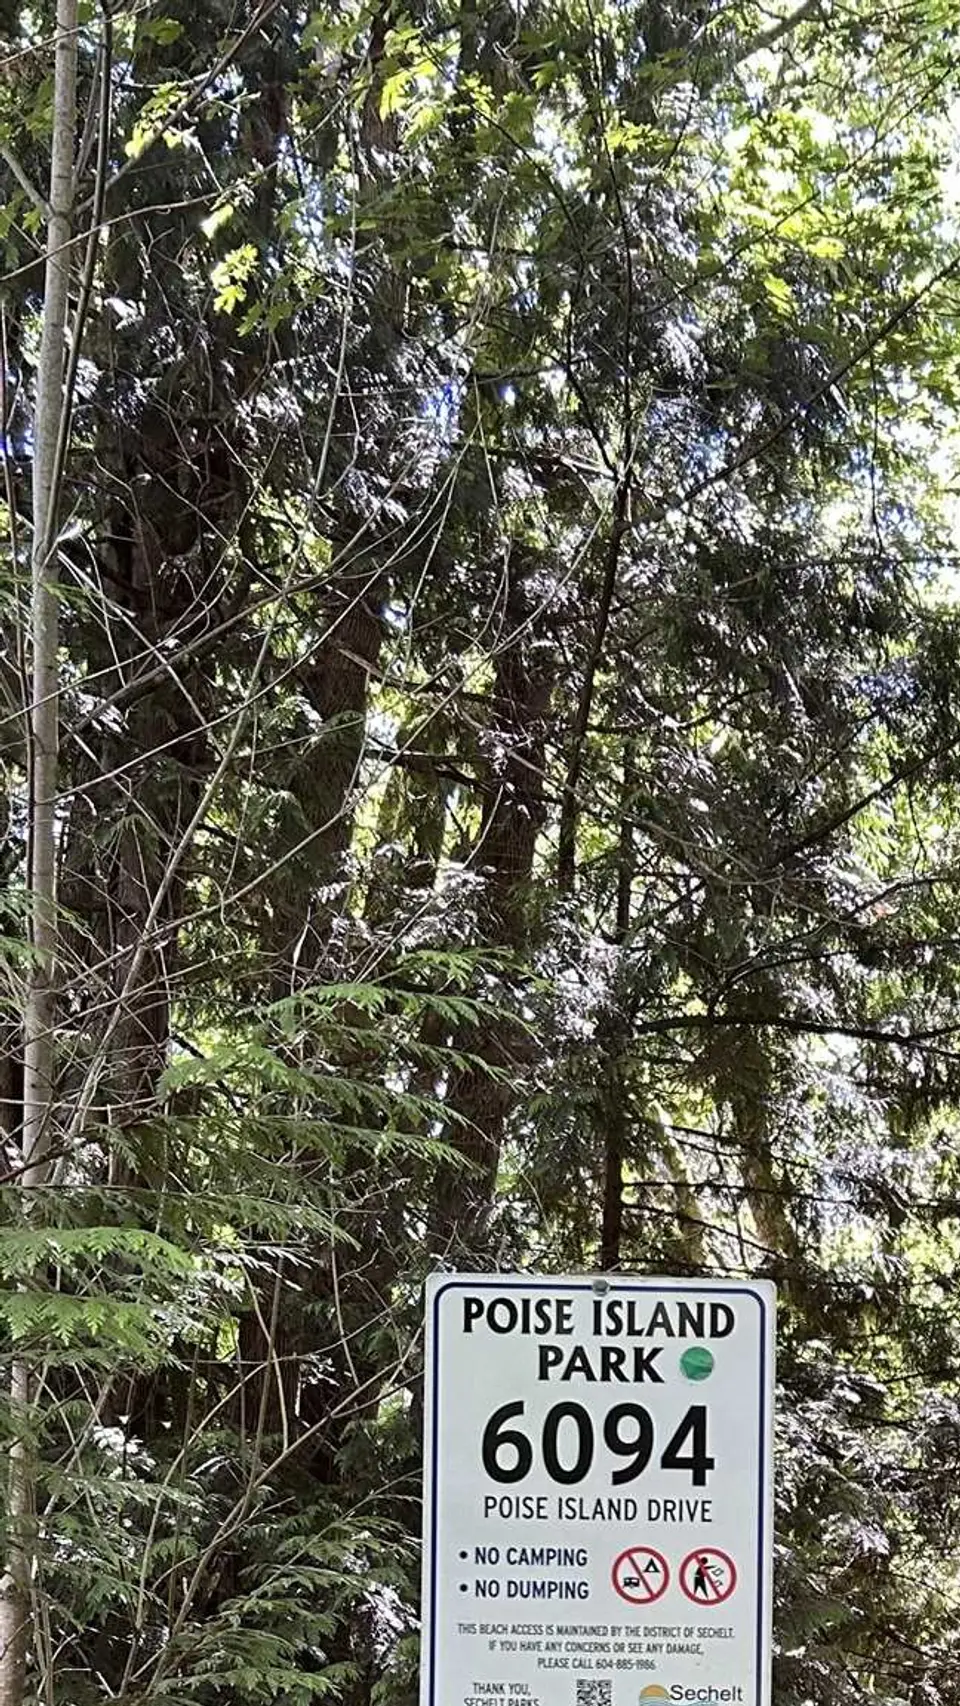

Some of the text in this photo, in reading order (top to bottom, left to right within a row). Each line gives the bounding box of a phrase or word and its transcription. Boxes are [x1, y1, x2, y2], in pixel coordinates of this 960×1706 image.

[462, 1296, 735, 1339] POISE ISLAND
[537, 1344, 665, 1384] PARK
[482, 1400, 715, 1486] 6094
[484, 1496, 713, 1523] POISE ISLAND DRIVE
[474, 1547, 588, 1567] NO CAMPING
[474, 1580, 589, 1600] NO DUMPING
[458, 1623, 477, 1634] THIS
[480, 1624, 508, 1635] BEACH
[511, 1624, 544, 1635] ACCESS
[546, 1624, 554, 1635] IS
[556, 1625, 609, 1636] MAINTAINED
[611, 1626, 622, 1636] BY
[625, 1626, 641, 1637] THE
[643, 1626, 681, 1637] DISTRICT
[683, 1627, 695, 1637] OF
[489, 1640, 497, 1650] IF
[500, 1640, 518, 1651] YOU
[520, 1641, 543, 1651] HAVE
[545, 1641, 562, 1652] ANY
[564, 1642, 611, 1653] CONCERNS
[613, 1643, 625, 1653] OR
[627, 1643, 643, 1653] SEE
[646, 1643, 663, 1654] ANY
[537, 1657, 570, 1669] PLEASE
[572, 1658, 593, 1669] CALL
[473, 1682, 532, 1697] THANK YOU,
[669, 1685, 743, 1701] Sechelt
